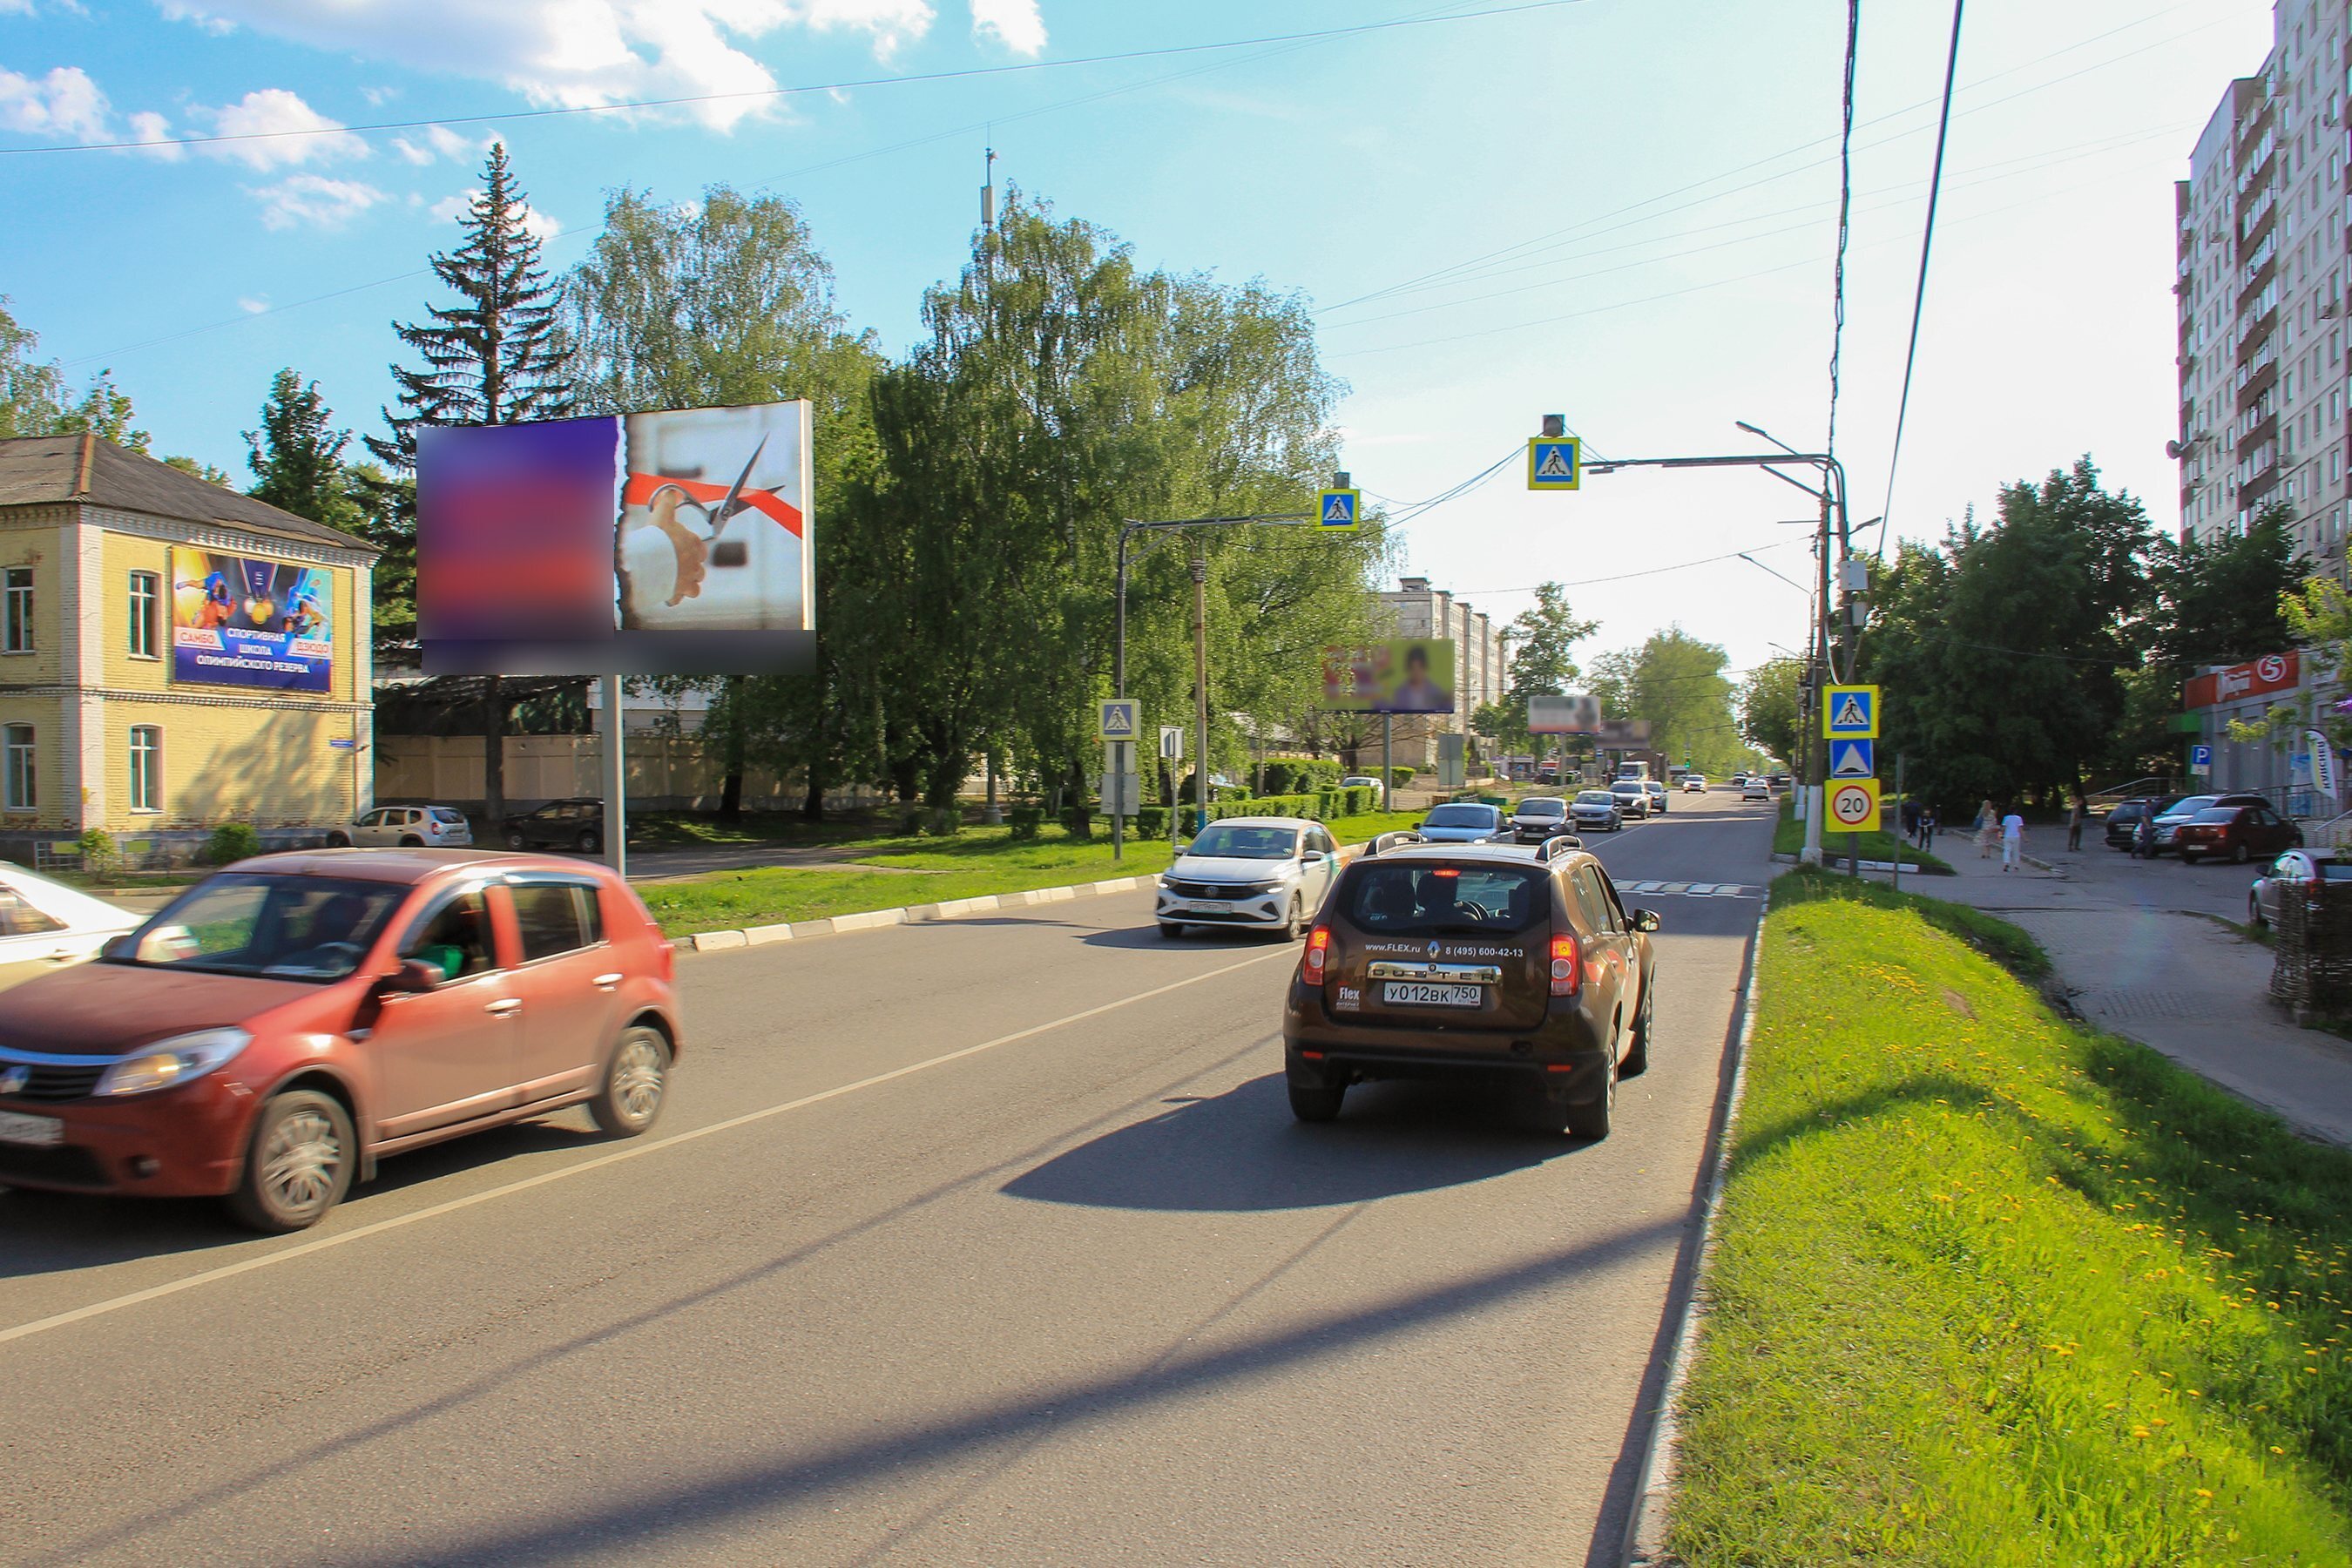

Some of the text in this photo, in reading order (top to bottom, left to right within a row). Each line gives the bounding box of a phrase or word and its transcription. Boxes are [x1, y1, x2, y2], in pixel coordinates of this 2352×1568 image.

[179, 632, 216, 645] САМБО
[226, 627, 287, 643] СПОРТИВНАЯ
[239, 644, 274, 656] ШКОЛА
[297, 641, 329, 654] ДЗЮДО
[196, 654, 310, 674] ОЛИМПИЙСКОГО РЕЗЕРВА
[1841, 797, 1863, 814] 20
[1365, 943, 1421, 954] www.FLEX.ru
[1445, 947, 1524, 957] 8 (495) 600-42-13
[1373, 968, 1494, 982] DUSTER
[1339, 986, 1360, 1001] Flex
[1453, 986, 1477, 999] 750
